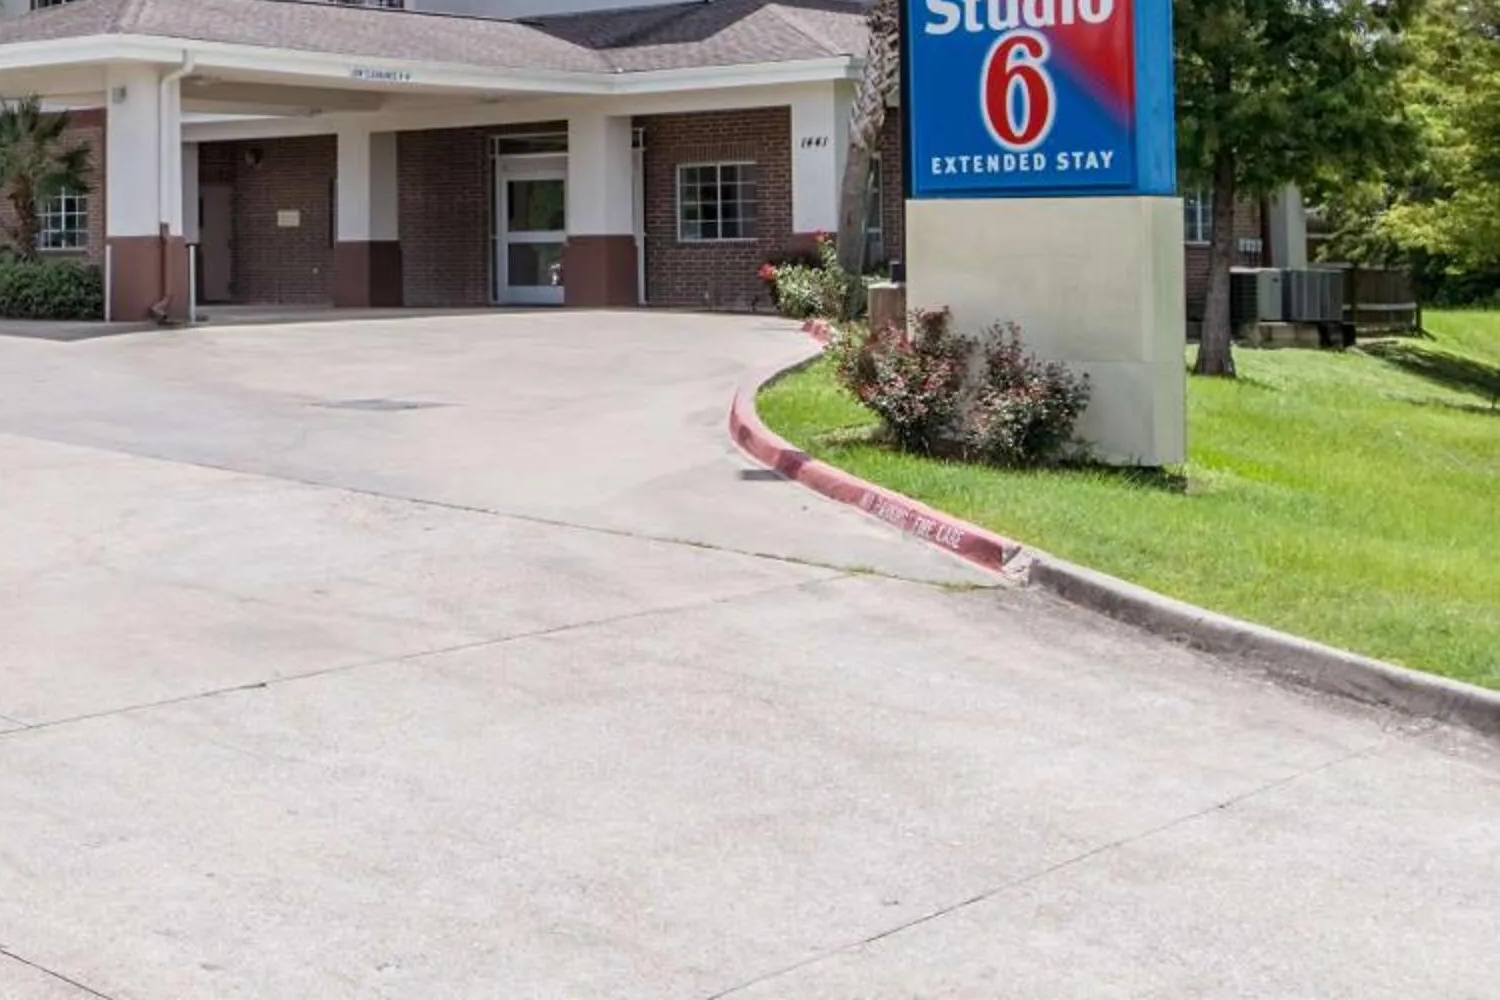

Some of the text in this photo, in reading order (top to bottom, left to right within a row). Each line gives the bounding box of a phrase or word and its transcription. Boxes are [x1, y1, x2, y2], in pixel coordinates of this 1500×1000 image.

[980, 27, 1057, 152] 6
[930, 150, 1115, 175] EXTENDED STAY
